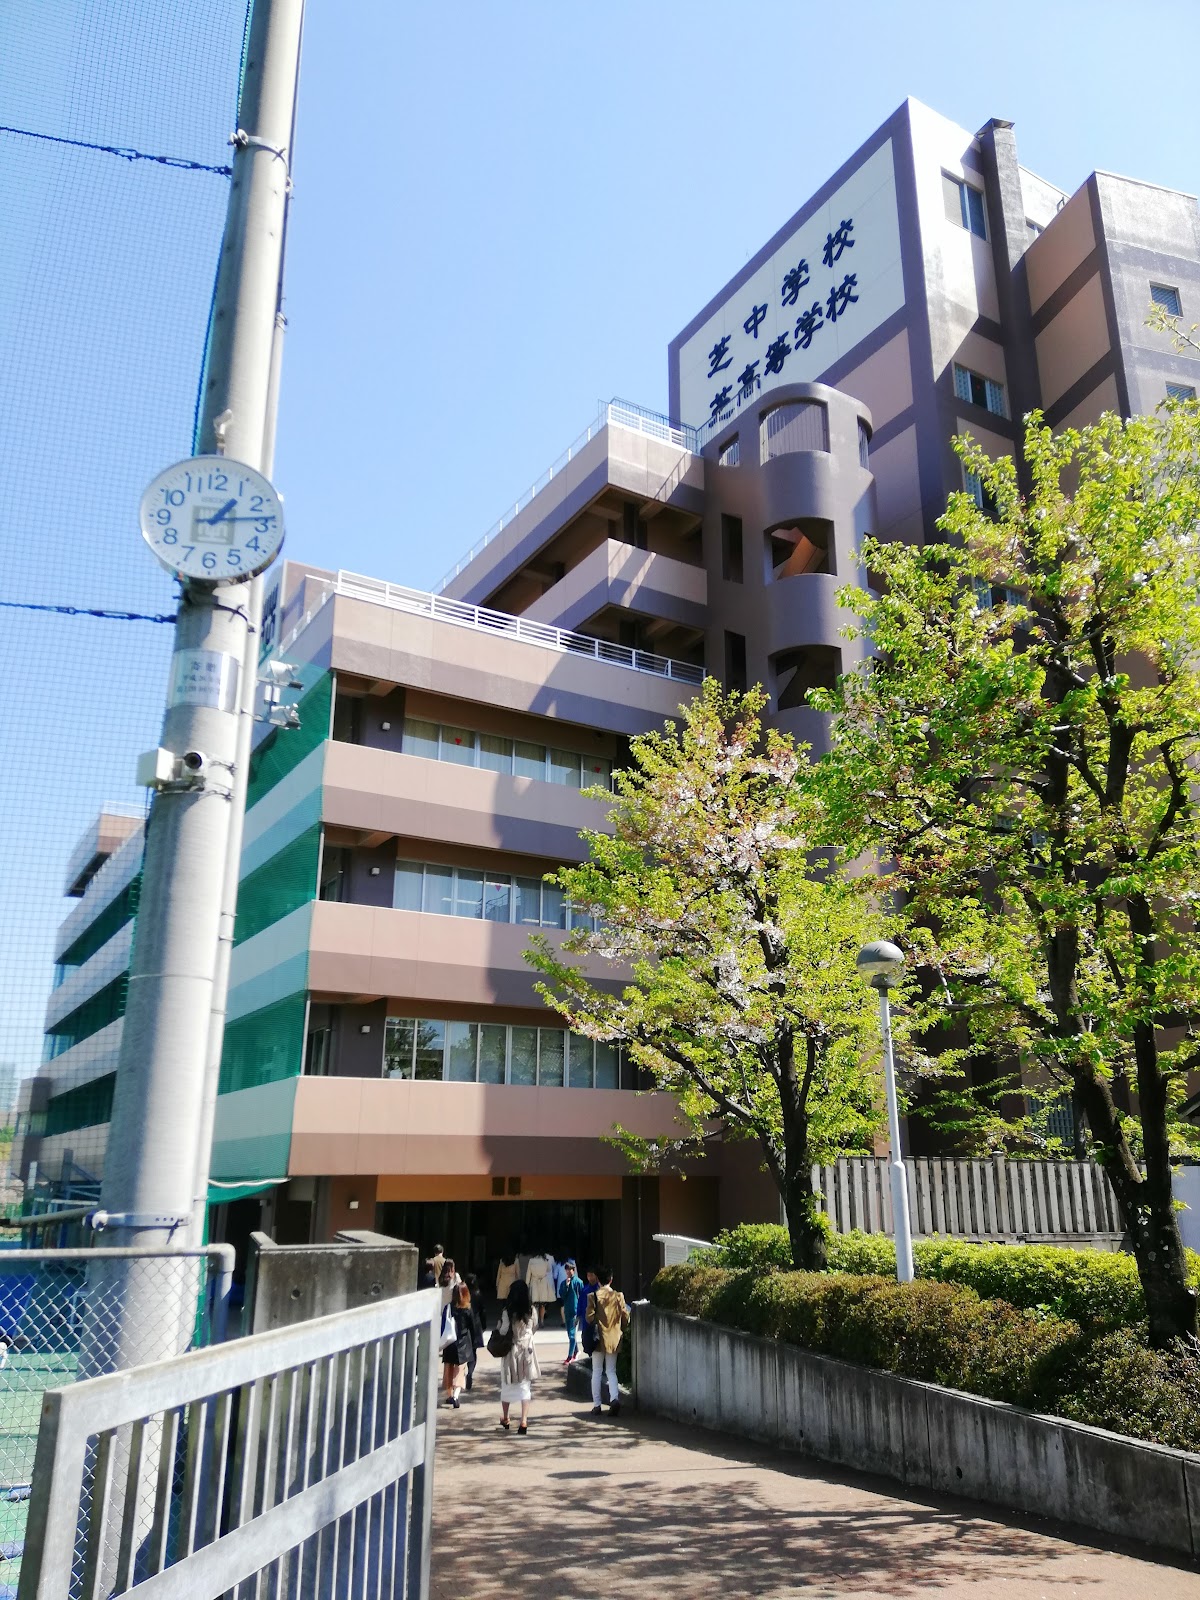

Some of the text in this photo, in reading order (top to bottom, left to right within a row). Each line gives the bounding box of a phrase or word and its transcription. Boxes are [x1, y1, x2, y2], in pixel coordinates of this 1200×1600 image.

[186, 476, 202, 493] 11
[207, 473, 229, 491] 12
[238, 480, 243, 497] 1
[164, 488, 185, 507] 10
[249, 495, 264, 512] 2
[156, 508, 171, 526] 9
[254, 516, 269, 533] 3
[162, 527, 178, 545] 8
[244, 535, 260, 551] 4
[181, 545, 196, 562] 7
[202, 551, 217, 569] 6
[226, 549, 241, 566] 5
